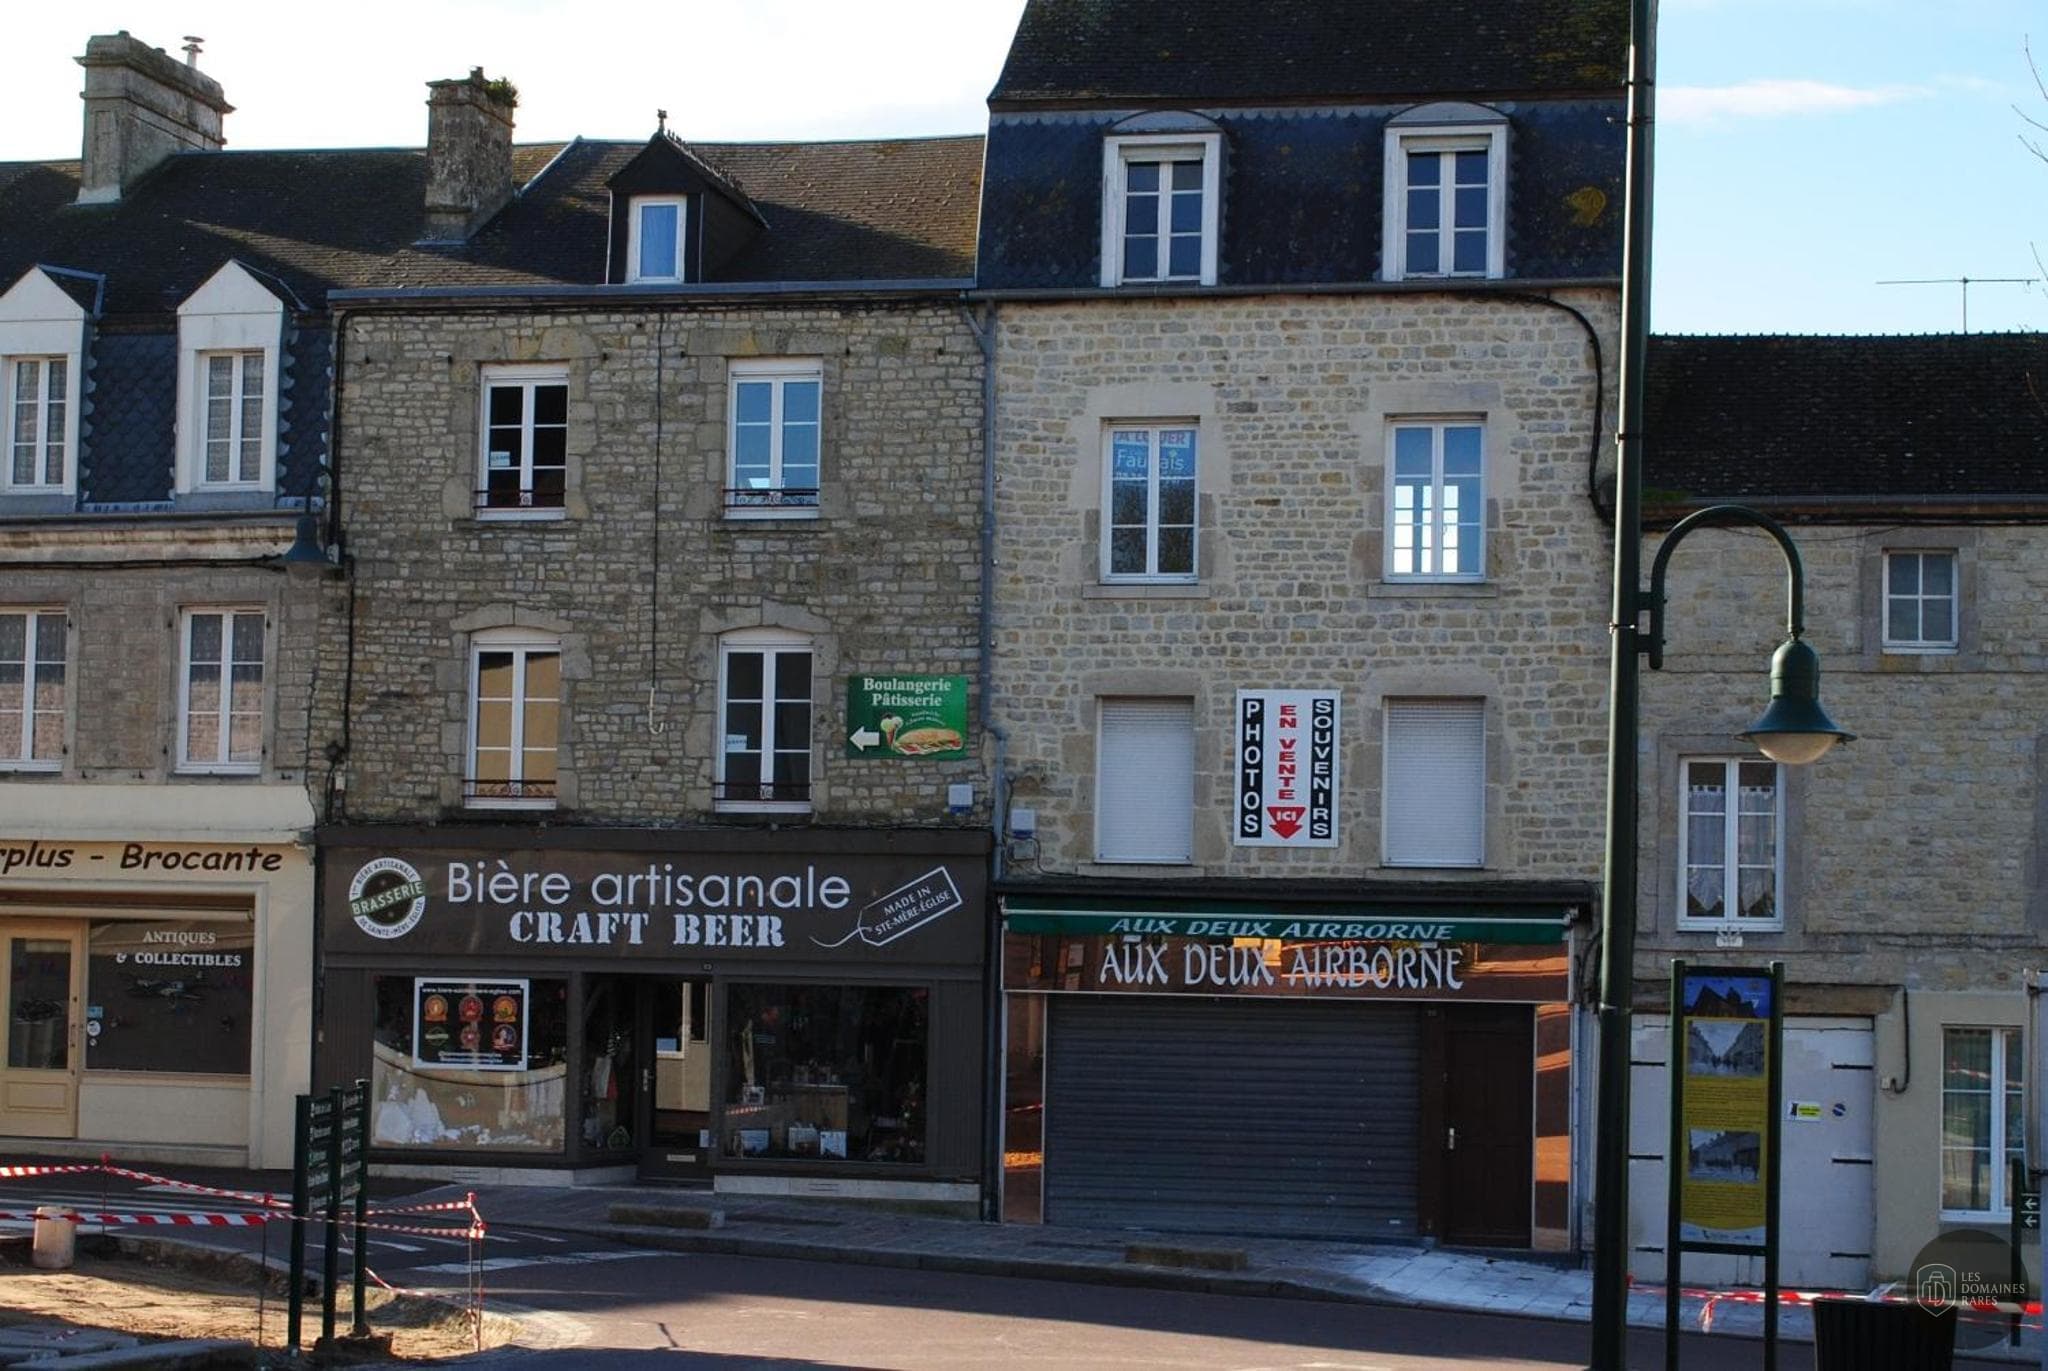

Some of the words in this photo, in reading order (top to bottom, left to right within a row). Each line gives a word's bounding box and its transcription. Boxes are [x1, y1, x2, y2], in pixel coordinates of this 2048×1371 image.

[1116, 448, 1185, 470] Fauais
[863, 678, 951, 694] Boulangerie
[871, 693, 942, 706] Pâtisserie
[1279, 705, 1297, 728] EN
[1243, 701, 1260, 833] PHOTOS
[1278, 739, 1296, 800] VENTE
[1313, 700, 1332, 836] SOUVENIRS
[1276, 811, 1297, 821] ICI
[120, 844, 282, 876] Brocante
[351, 881, 425, 915] BRASSERIE
[447, 860, 572, 904] Bière
[591, 863, 851, 909] artisanale
[883, 894, 915, 916] MADE
[917, 886, 931, 899] IN
[143, 931, 216, 945] ANTIQUES
[509, 911, 649, 945] CRAFT
[672, 913, 785, 947] BEER
[1108, 918, 1177, 934] AUX
[1185, 920, 1272, 937] DEUX
[1280, 922, 1456, 940] AIRBORNE
[116, 953, 127, 964] &
[135, 953, 241, 967] COLLECTIBLES
[1100, 943, 1168, 985] AUX
[1183, 944, 1274, 986] DEUX
[1289, 945, 1464, 989] AIRBORNE
